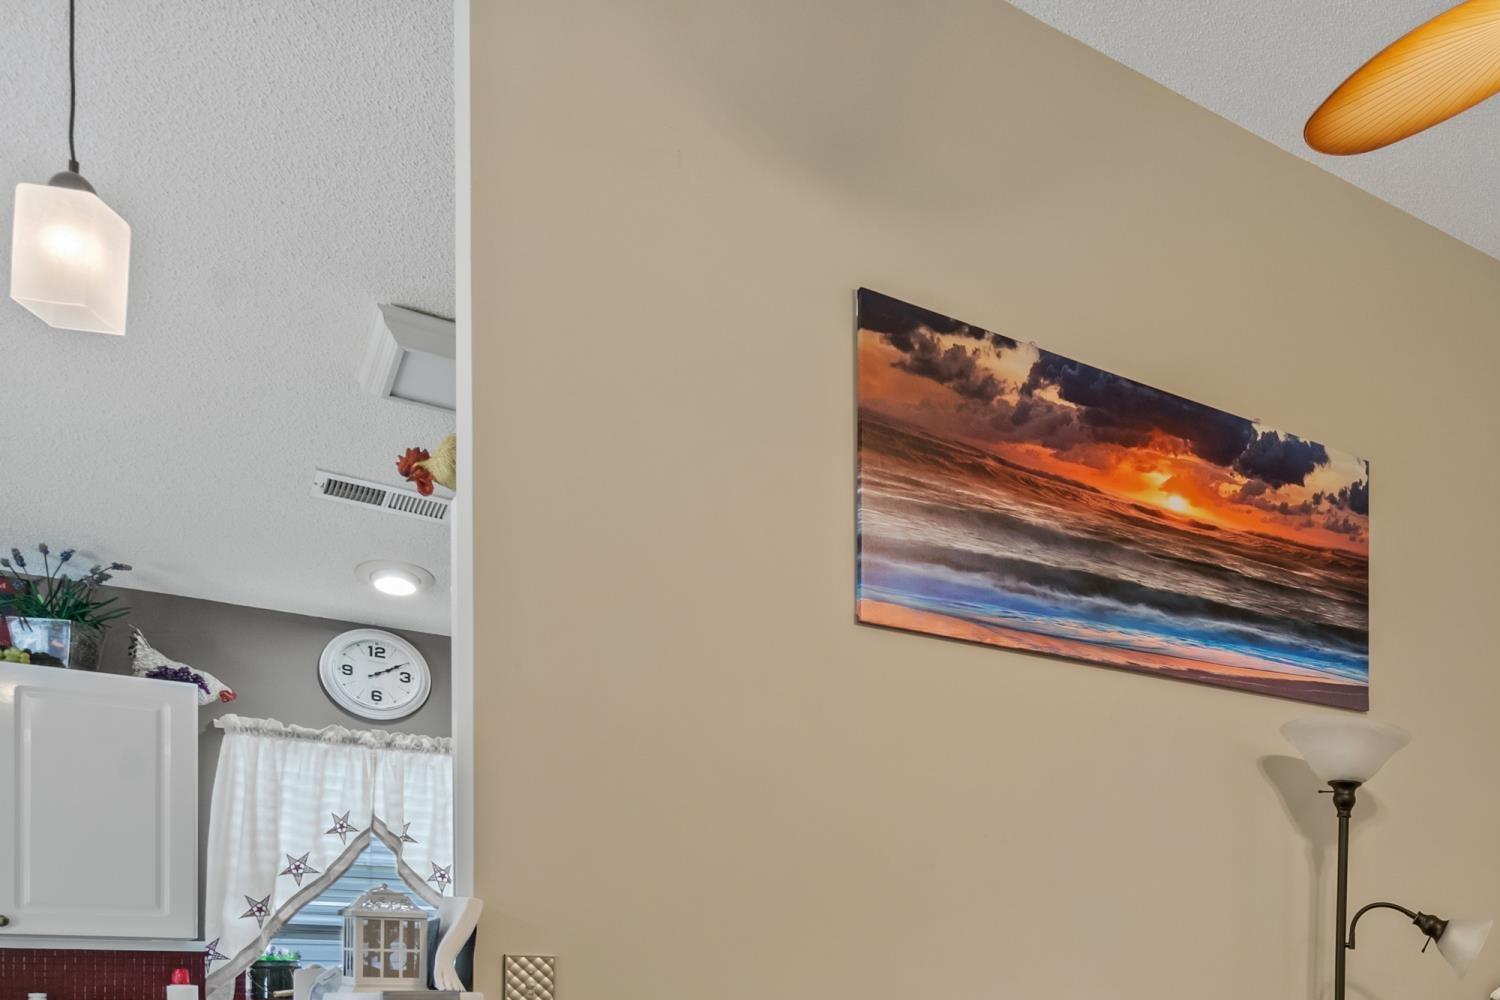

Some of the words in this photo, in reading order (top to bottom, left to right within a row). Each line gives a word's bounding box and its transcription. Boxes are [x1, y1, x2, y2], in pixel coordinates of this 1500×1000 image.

[368, 645, 386, 659] 12
[342, 664, 353, 676] 9
[399, 672, 411, 683] 3
[371, 690, 382, 702] 6
